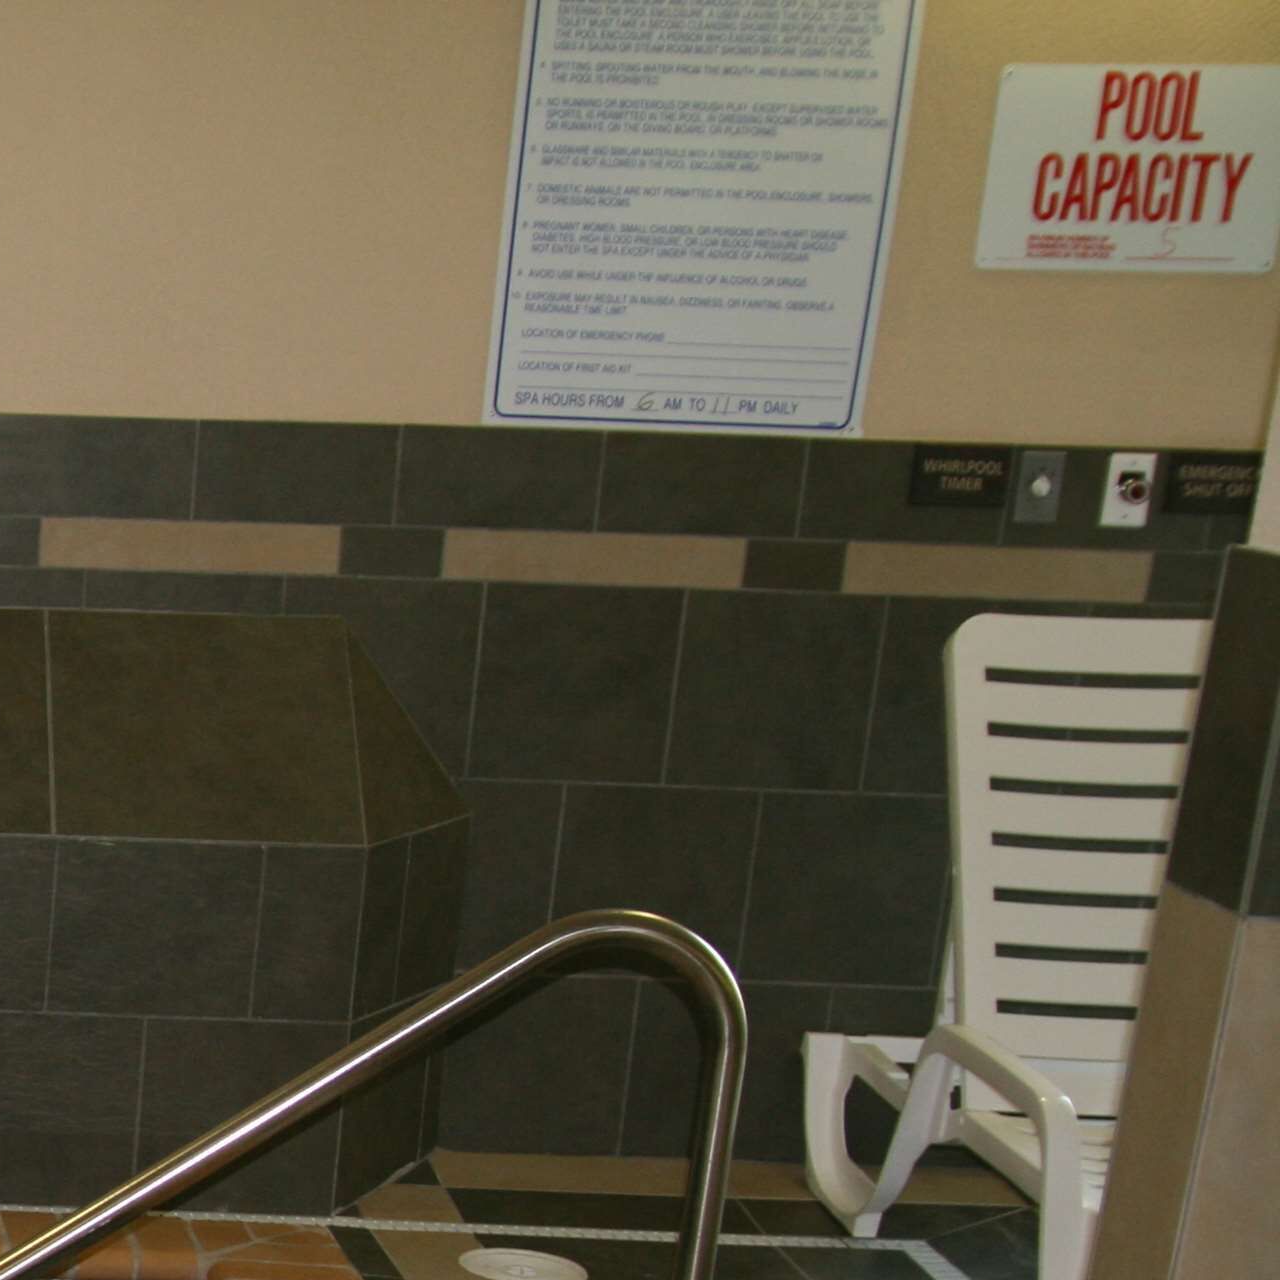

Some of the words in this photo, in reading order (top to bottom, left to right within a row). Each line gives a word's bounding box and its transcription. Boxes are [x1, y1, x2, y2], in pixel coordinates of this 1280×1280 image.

[1094, 70, 1205, 142] POOL
[1031, 152, 1255, 224] CAPACITY
[513, 391, 539, 406] SPA
[540, 392, 587, 407] HOURS
[587, 393, 625, 408] FROM
[662, 397, 683, 410] AM
[687, 397, 707, 411] TO
[737, 399, 758, 413] PM
[761, 399, 799, 415] DAILY
[923, 458, 1003, 474] WHIRLPOOL
[1178, 464, 1256, 480] EMERGENC
[941, 476, 983, 491] TIMER
